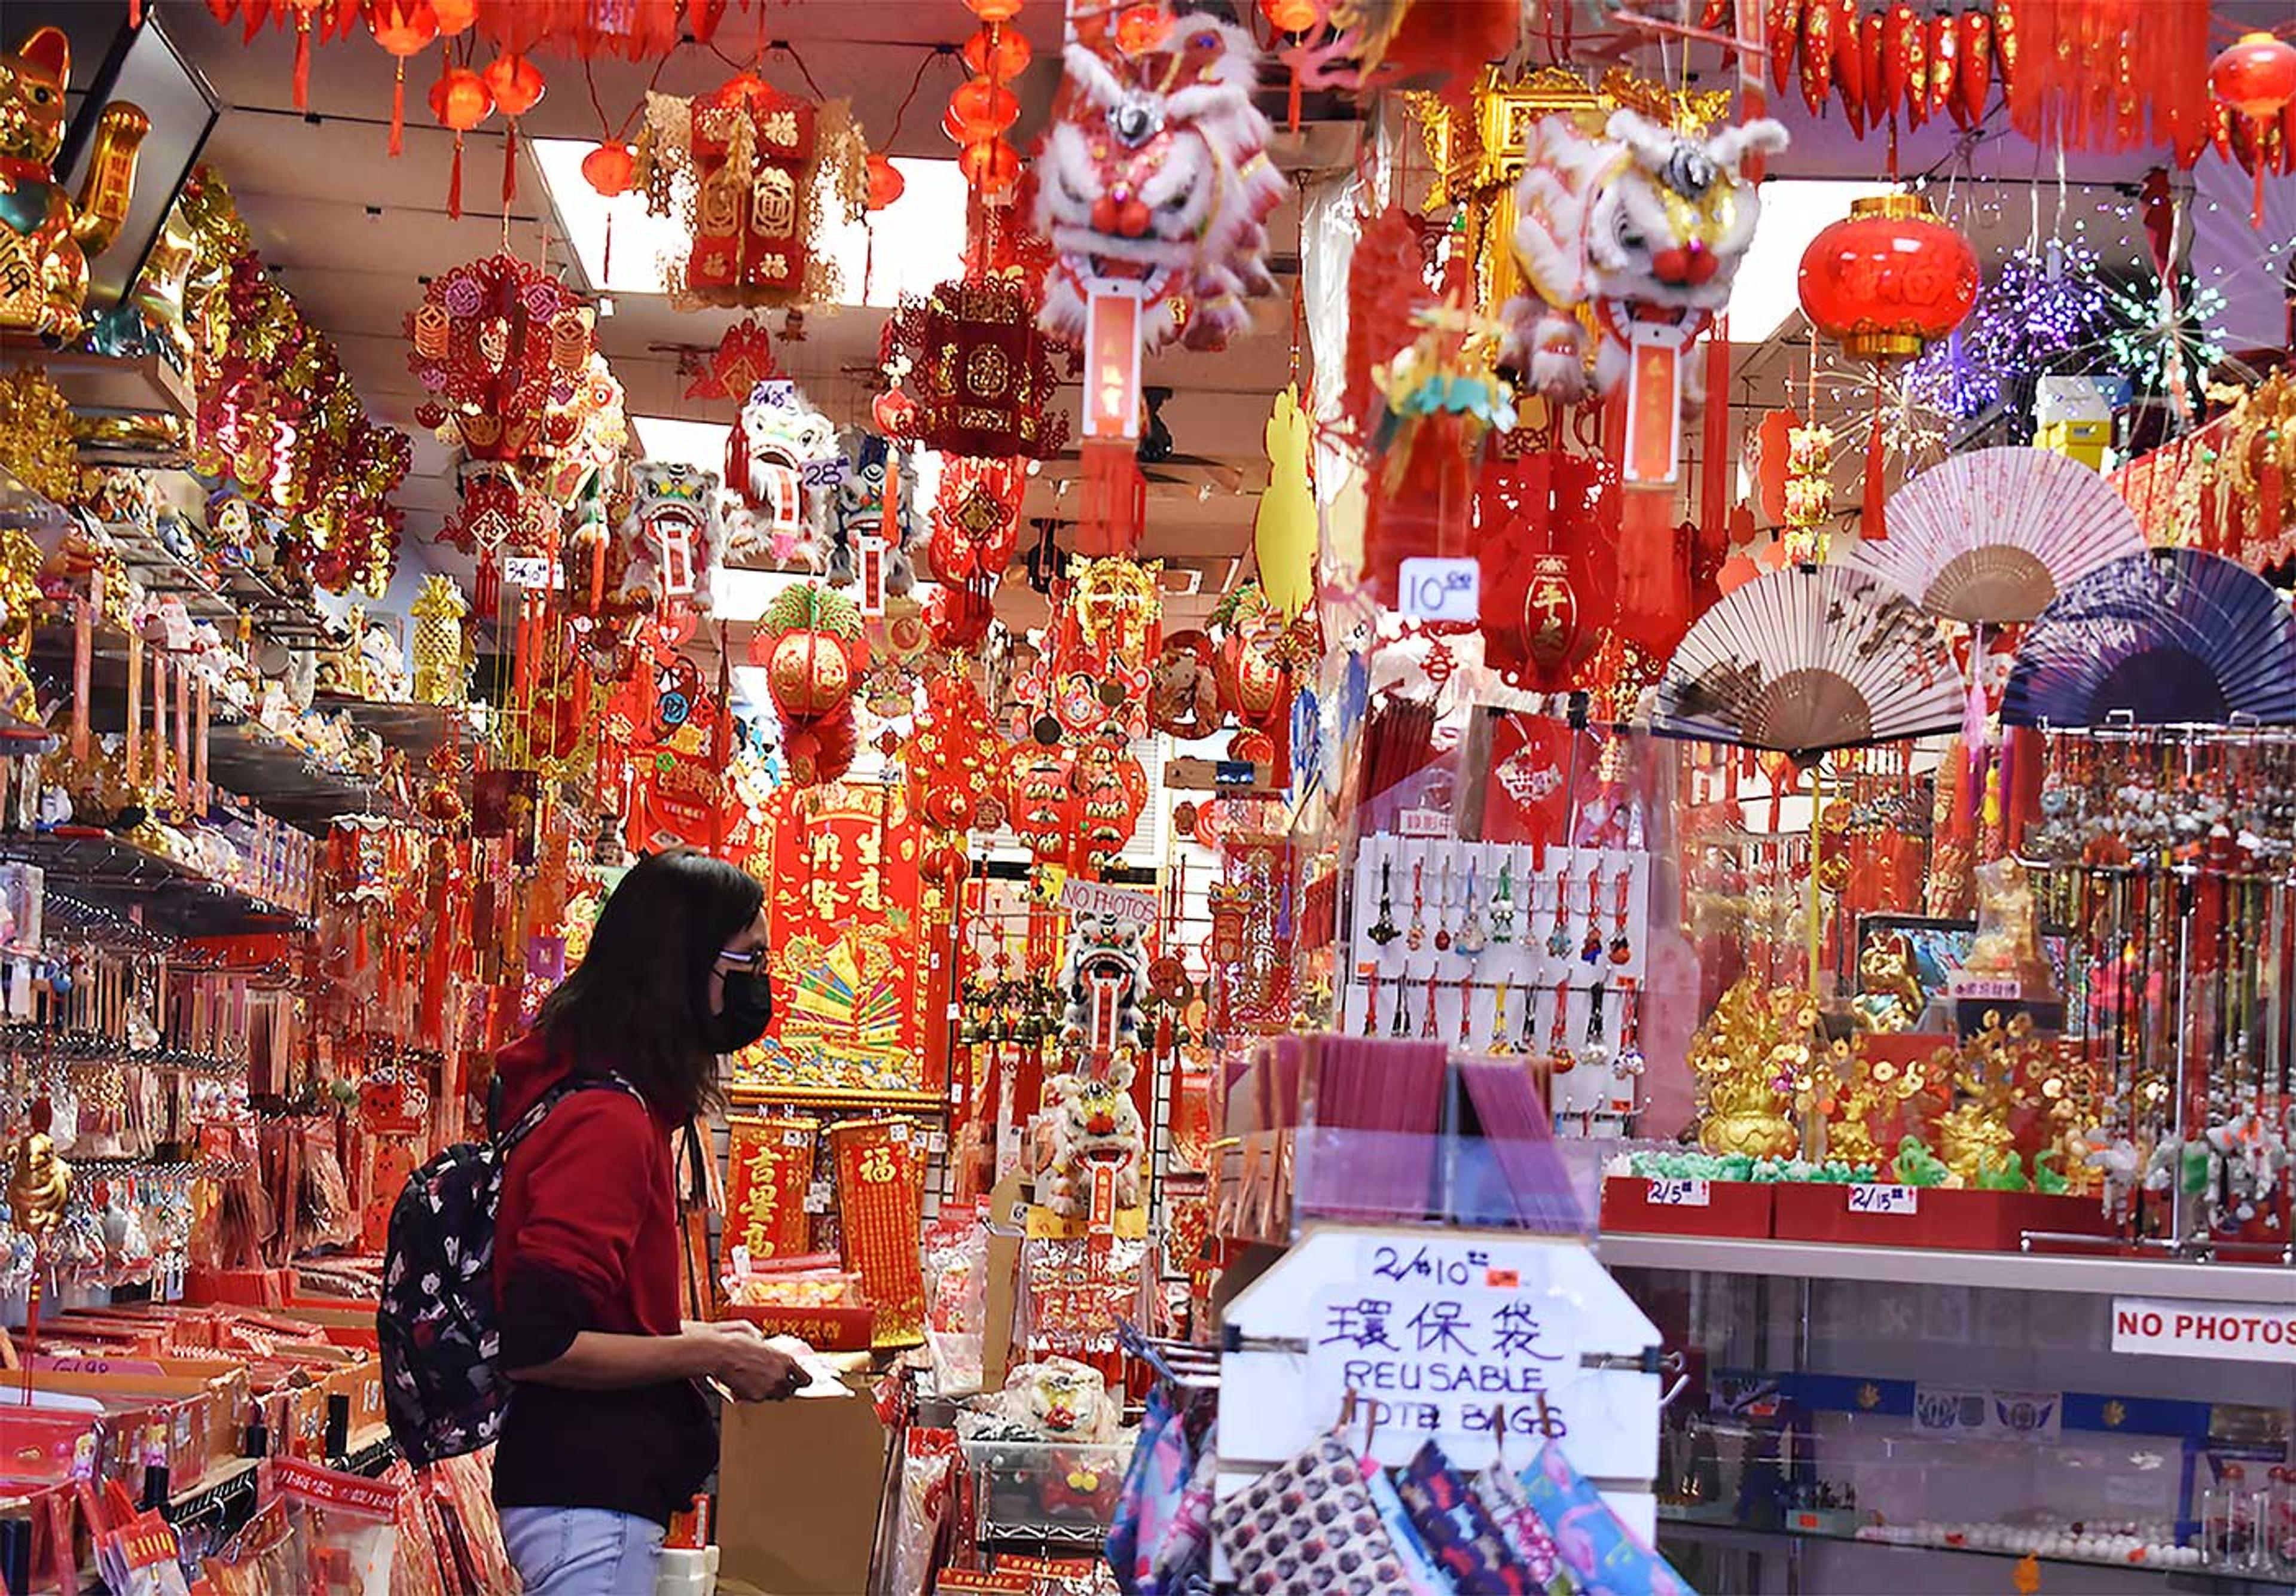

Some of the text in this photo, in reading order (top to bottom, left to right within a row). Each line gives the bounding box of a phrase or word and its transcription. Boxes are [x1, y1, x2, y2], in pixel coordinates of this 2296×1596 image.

[1061, 883, 1156, 924] NO PHOTOS
[859, 1147, 896, 1183] 福
[1320, 1299, 1563, 1361] 環保袋
[2117, 1312, 2162, 1337] NO
[1345, 1360, 1546, 1393] REUSABLE
[1461, 1403, 1567, 1439] BAGS
